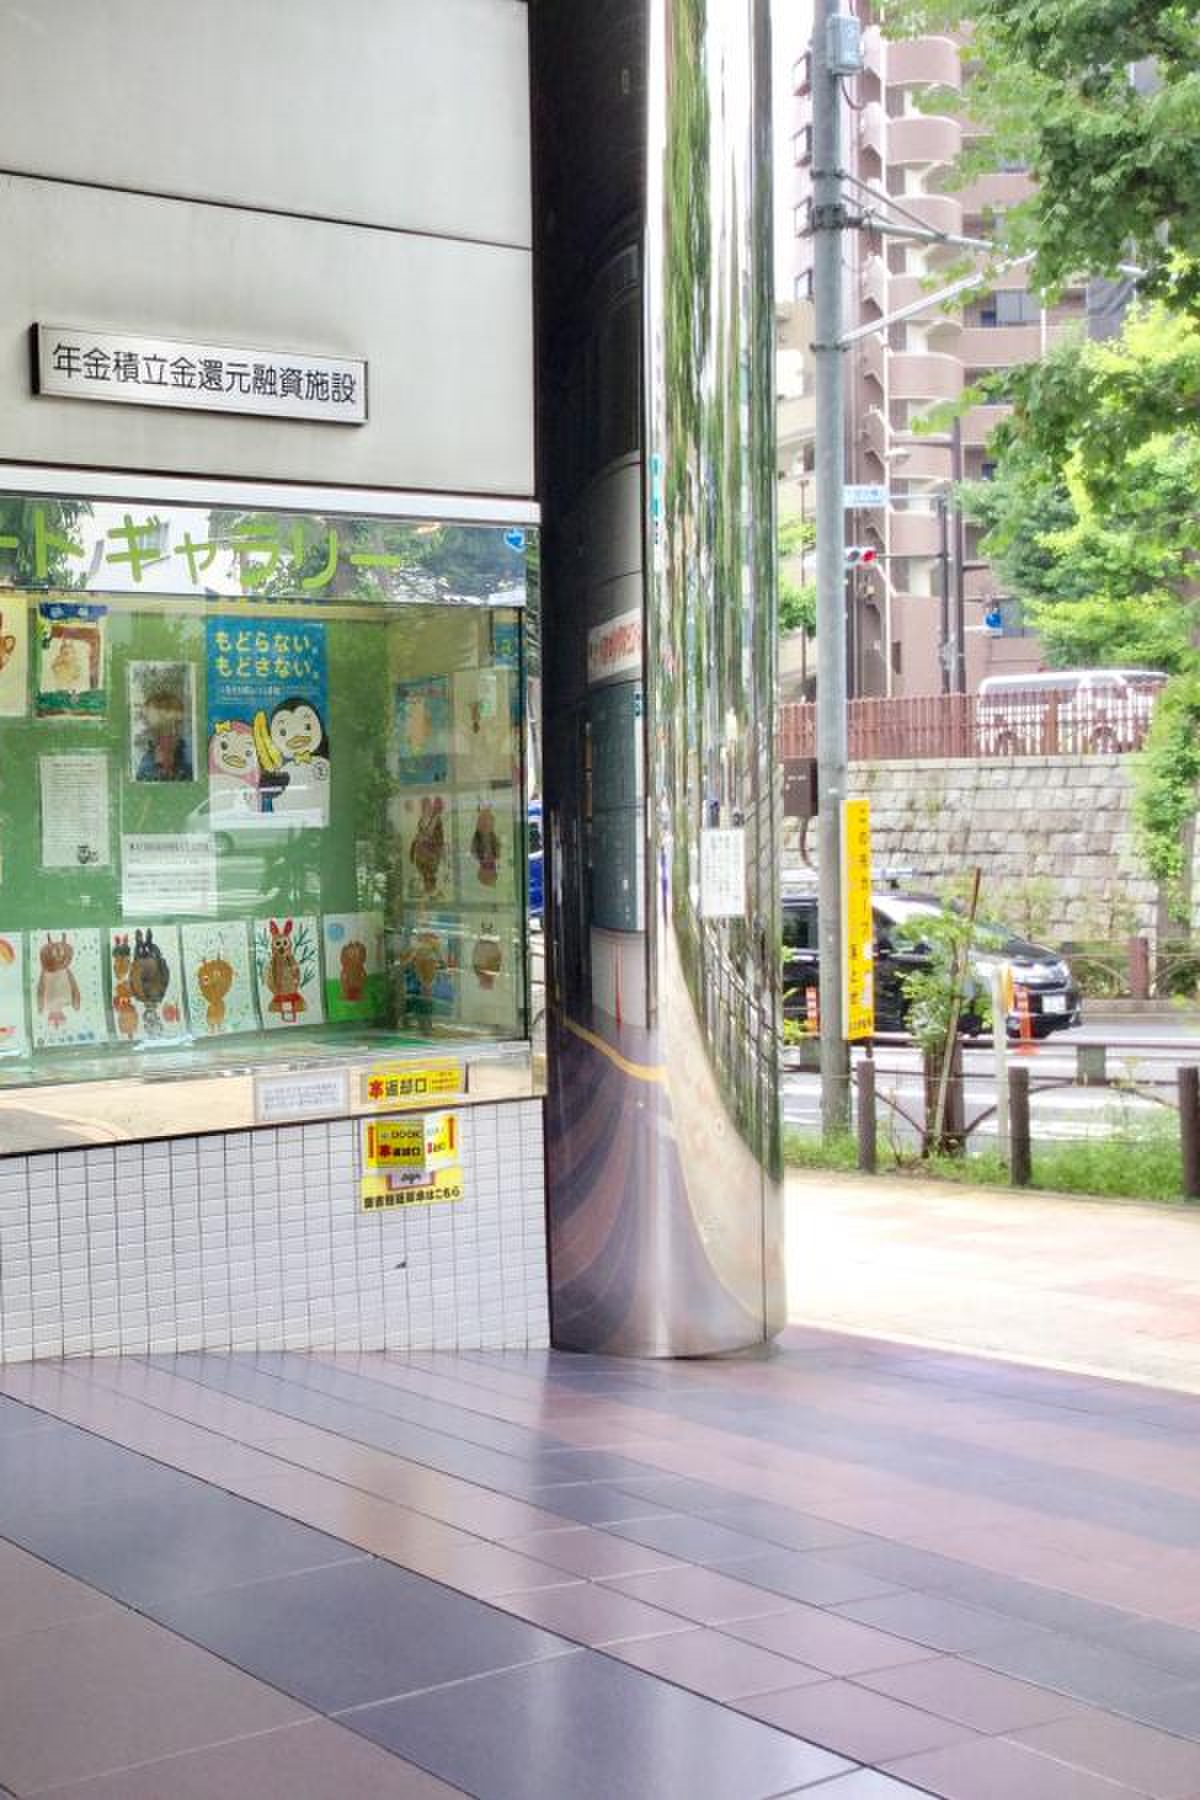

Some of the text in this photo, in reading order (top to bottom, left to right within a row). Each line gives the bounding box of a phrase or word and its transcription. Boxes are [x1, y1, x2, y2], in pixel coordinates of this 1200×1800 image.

[52, 344, 356, 404] 年金積立金還元融資施設
